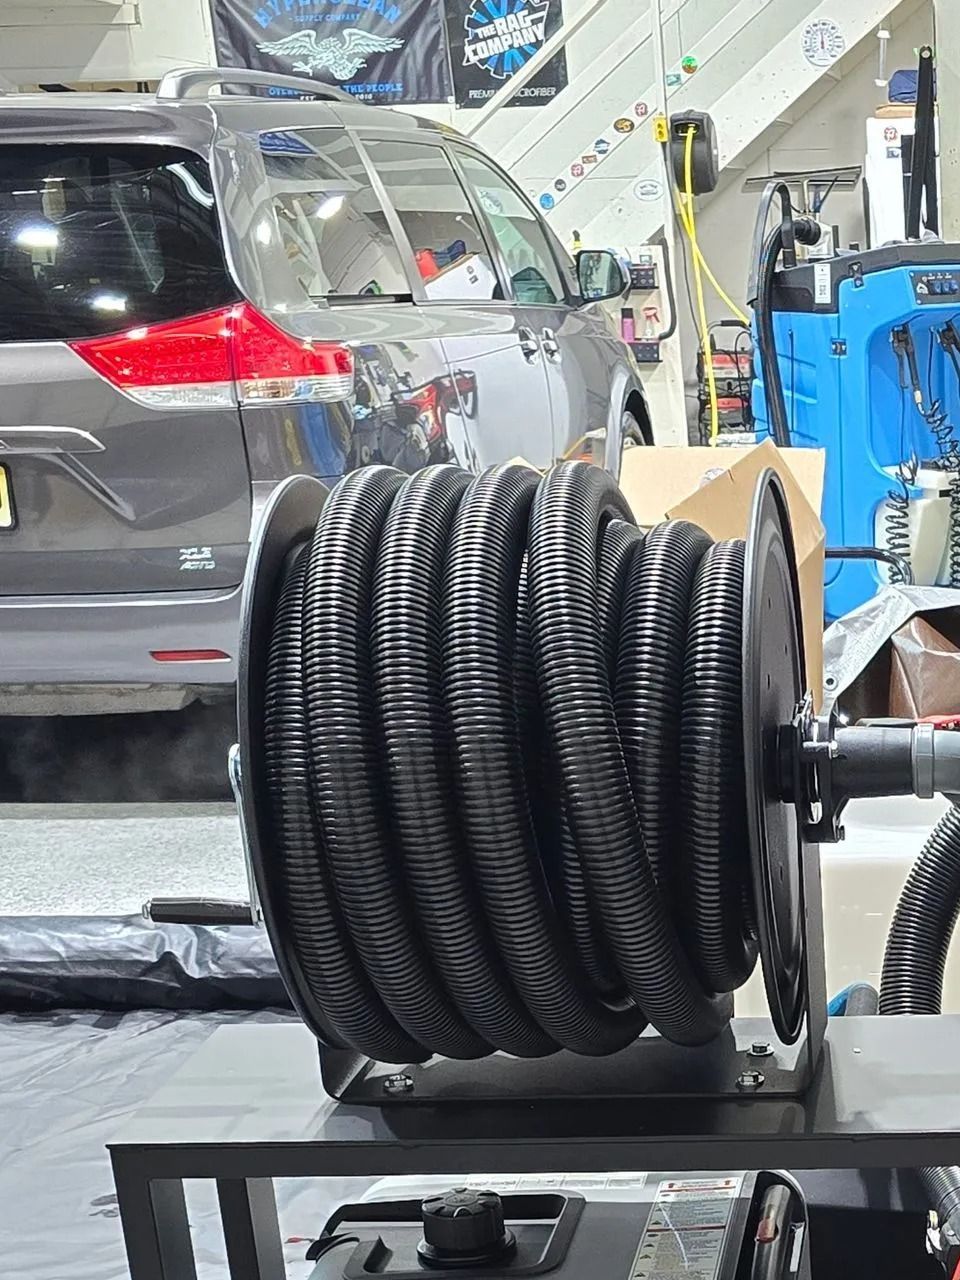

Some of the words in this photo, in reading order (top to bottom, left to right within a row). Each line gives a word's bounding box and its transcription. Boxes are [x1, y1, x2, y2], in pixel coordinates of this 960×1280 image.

[475, 24, 497, 39] THE
[493, 9, 532, 37] RAG
[466, 22, 546, 63] COMPANY
[366, 83, 403, 93] PEOPLE
